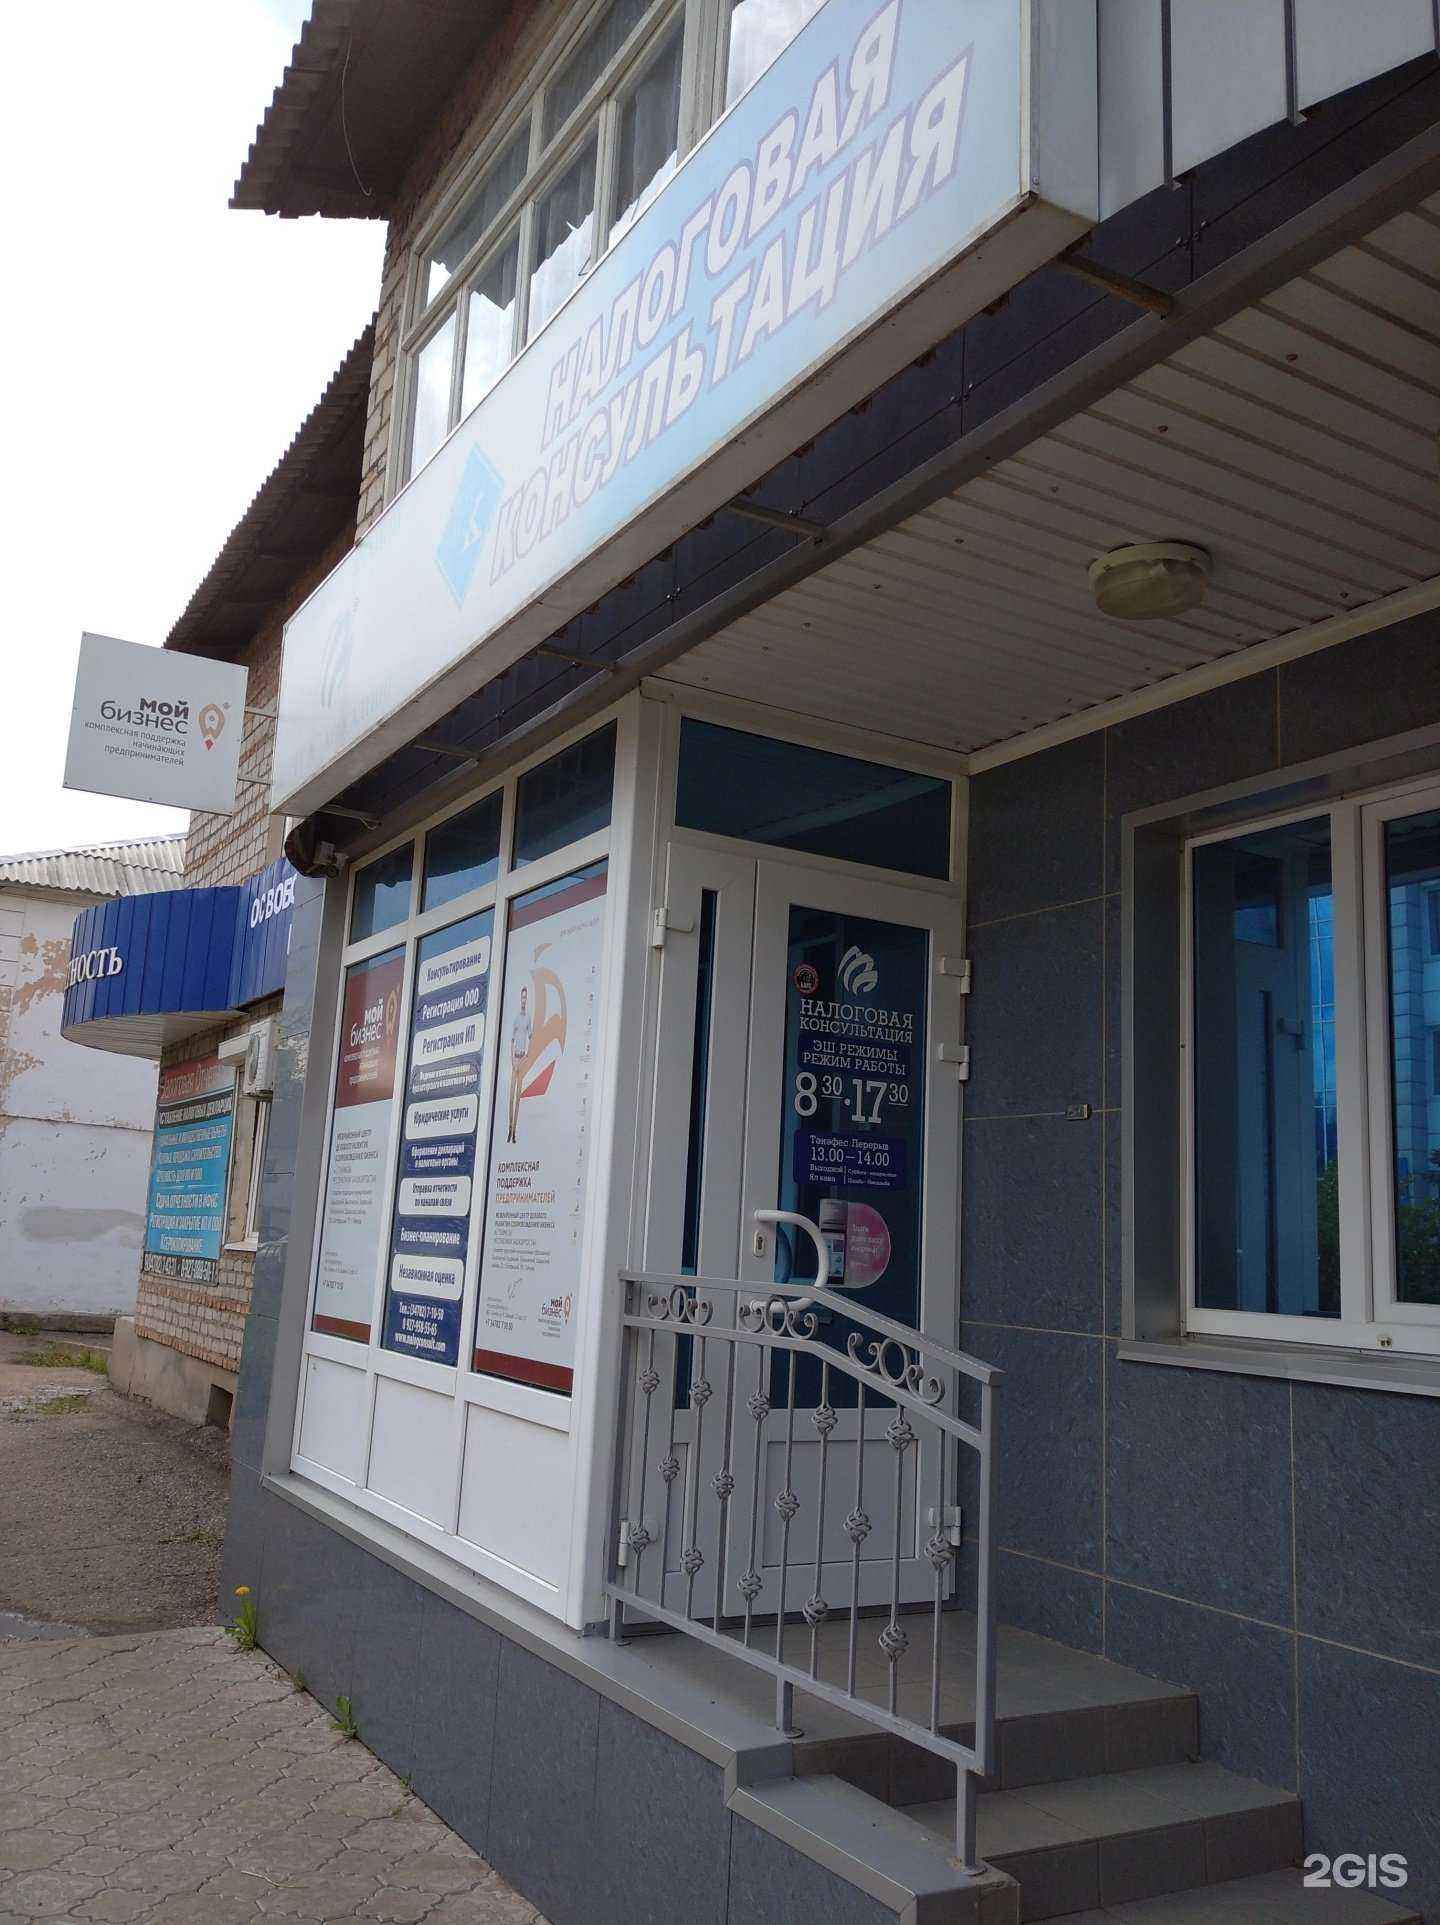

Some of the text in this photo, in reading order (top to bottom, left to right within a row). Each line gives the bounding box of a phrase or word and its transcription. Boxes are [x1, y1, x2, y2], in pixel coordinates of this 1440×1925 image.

[541, 0, 900, 452] НАЛОГОВАЯ
[489, 42, 975, 586] КОНСУЛЬТАЦИЯ
[100, 700, 189, 734] бизнес
[140, 698, 189, 719] мой
[84, 720, 186, 748] комплексная поддержка
[104, 745, 184, 766] предпринимателей
[132, 740, 185, 757] начинающих
[251, 873, 297, 928] ОСВОБ
[426, 953, 481, 981] Консультирование
[364, 996, 384, 1026] мой
[422, 987, 479, 1020] Регистрация ООО
[800, 998, 913, 1029] НАЛОГОВАЯ
[350, 1022, 383, 1047] бизнес
[422, 1024, 476, 1054] Регистрация ИП
[800, 1016, 912, 1044] КОНСУЛЬТАЦИЯ
[803, 1052, 906, 1075] РЕЖИМ РАБОТЫ
[813, 1040, 897, 1061] ЭШ РЕЖИМЫ
[413, 1107, 469, 1127] Юридические услуги
[851, 1138, 889, 1151] Перерыв
[498, 1160, 540, 1173] КОМПЛЕКСНАЯ
[496, 1177, 531, 1189] ПОДДЕРЖКА
[400, 1227, 460, 1246] Бизнес-планирование
